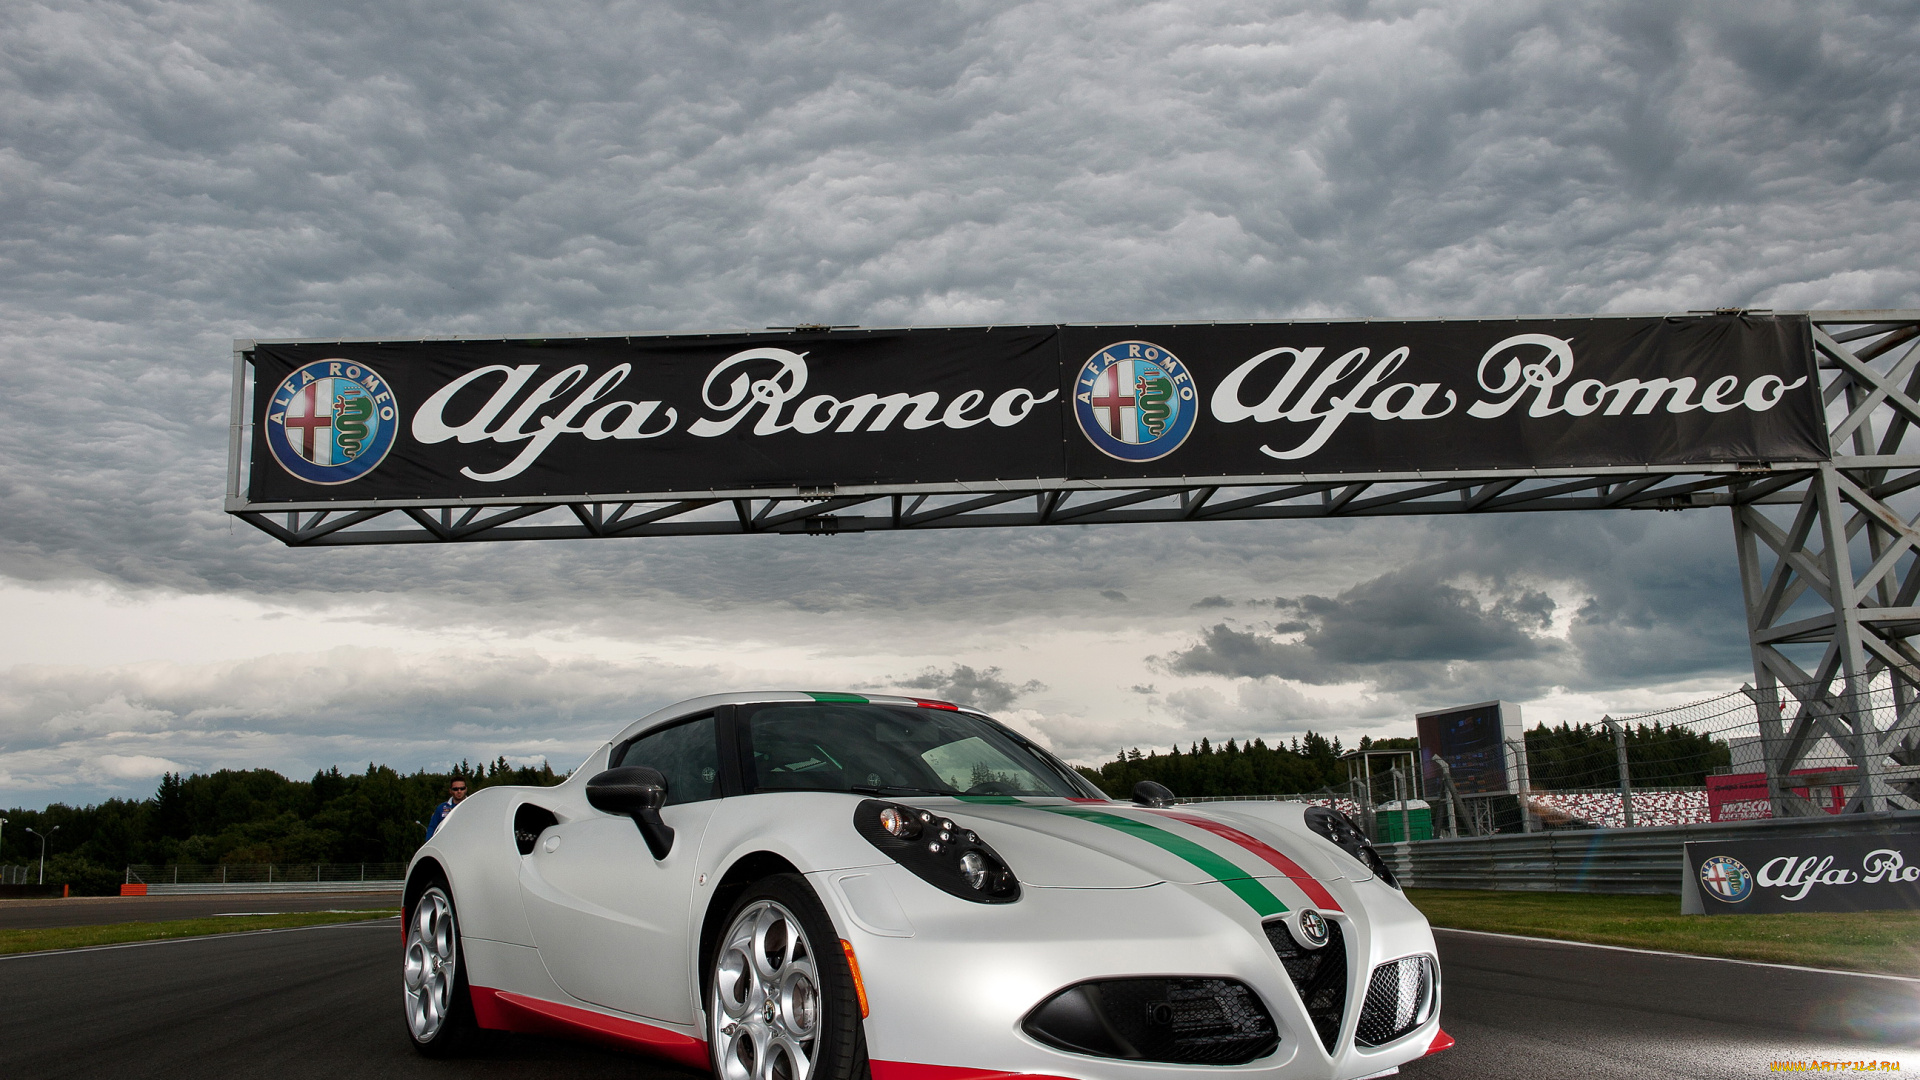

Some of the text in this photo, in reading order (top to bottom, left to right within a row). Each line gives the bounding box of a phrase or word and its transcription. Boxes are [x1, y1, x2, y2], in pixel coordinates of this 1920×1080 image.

[270, 362, 394, 425] ALFA ROMEO
[1077, 344, 1194, 405] ALFA ROMEO
[1210, 333, 1808, 460] Alfa Romeo
[411, 347, 1060, 482] Alfa Romeo
[1720, 800, 1772, 814] MOSCO
[1702, 857, 1750, 881] ALFA ROMEO
[1756, 855, 1858, 901] Alfa
